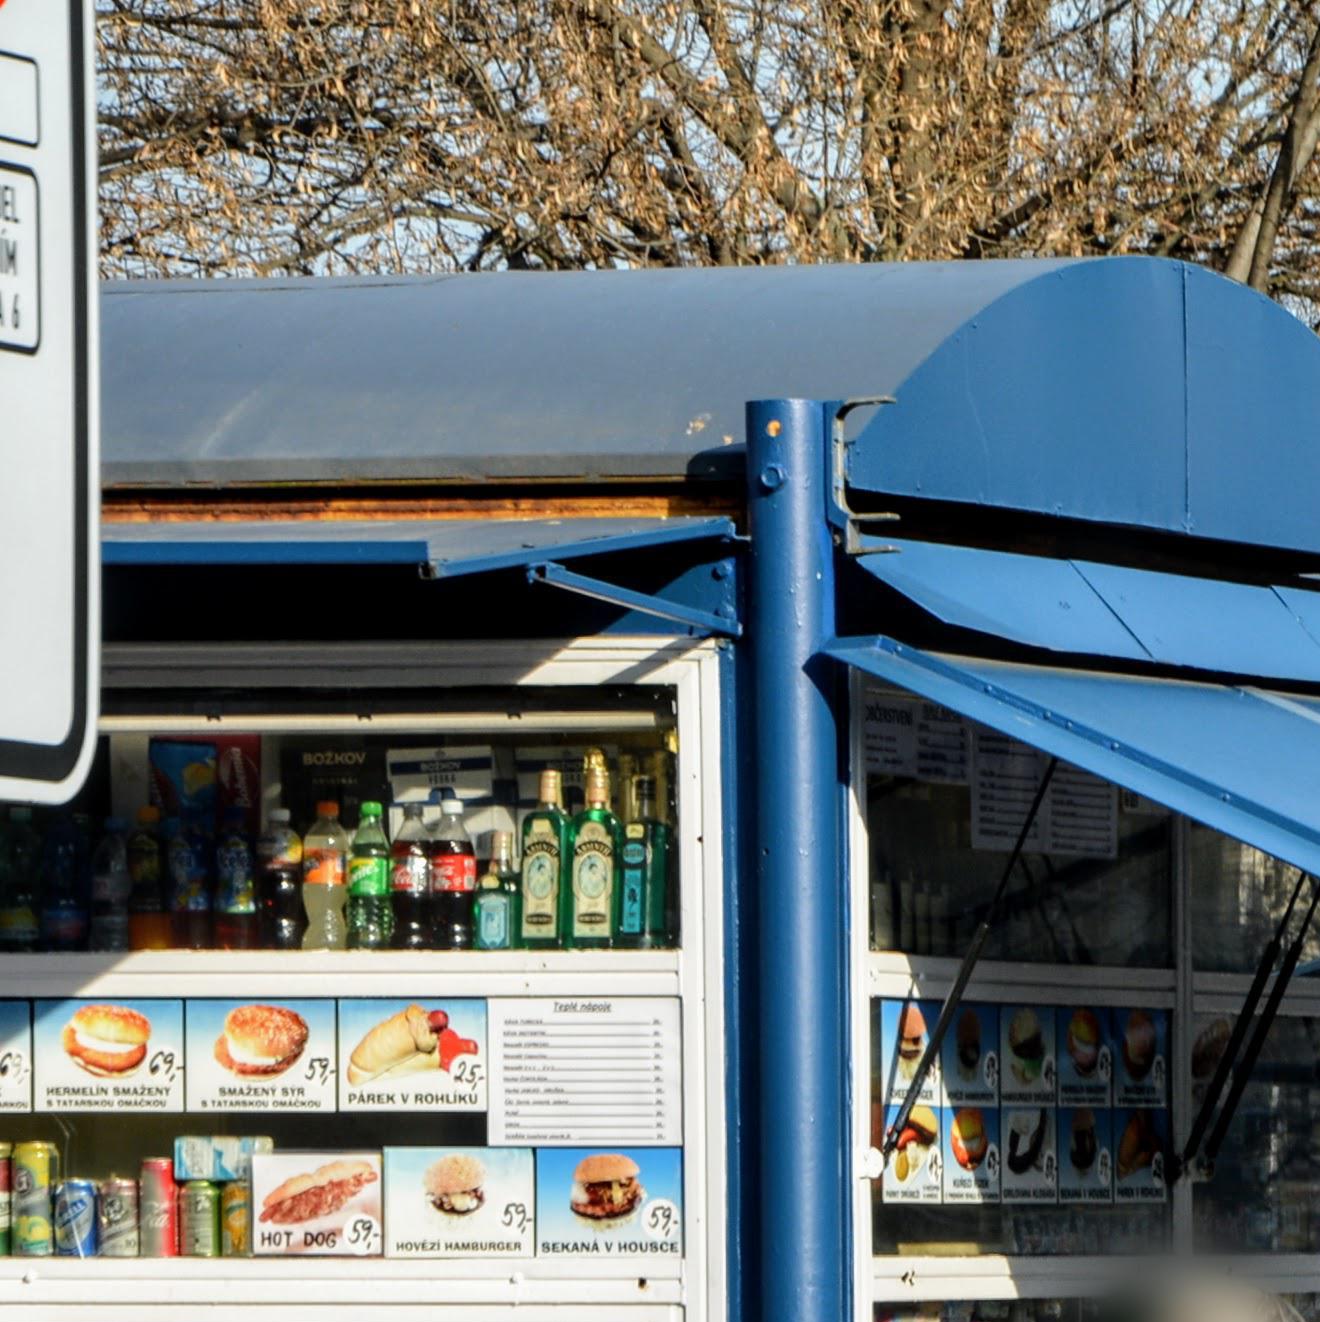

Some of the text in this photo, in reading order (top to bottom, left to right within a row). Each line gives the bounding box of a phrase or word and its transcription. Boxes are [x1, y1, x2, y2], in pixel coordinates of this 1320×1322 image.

[453, 1061, 485, 1090] 25,-
[348, 1091, 478, 1104] PÁREK V ROHLÍKU
[648, 1206, 678, 1236] 59,-
[261, 1231, 337, 1248] HOT DOG
[348, 1218, 380, 1248] 59,-
[444, 1241, 522, 1252] HAMBURGER
[541, 1238, 679, 1254] SEKANÁ V HOUSCE
